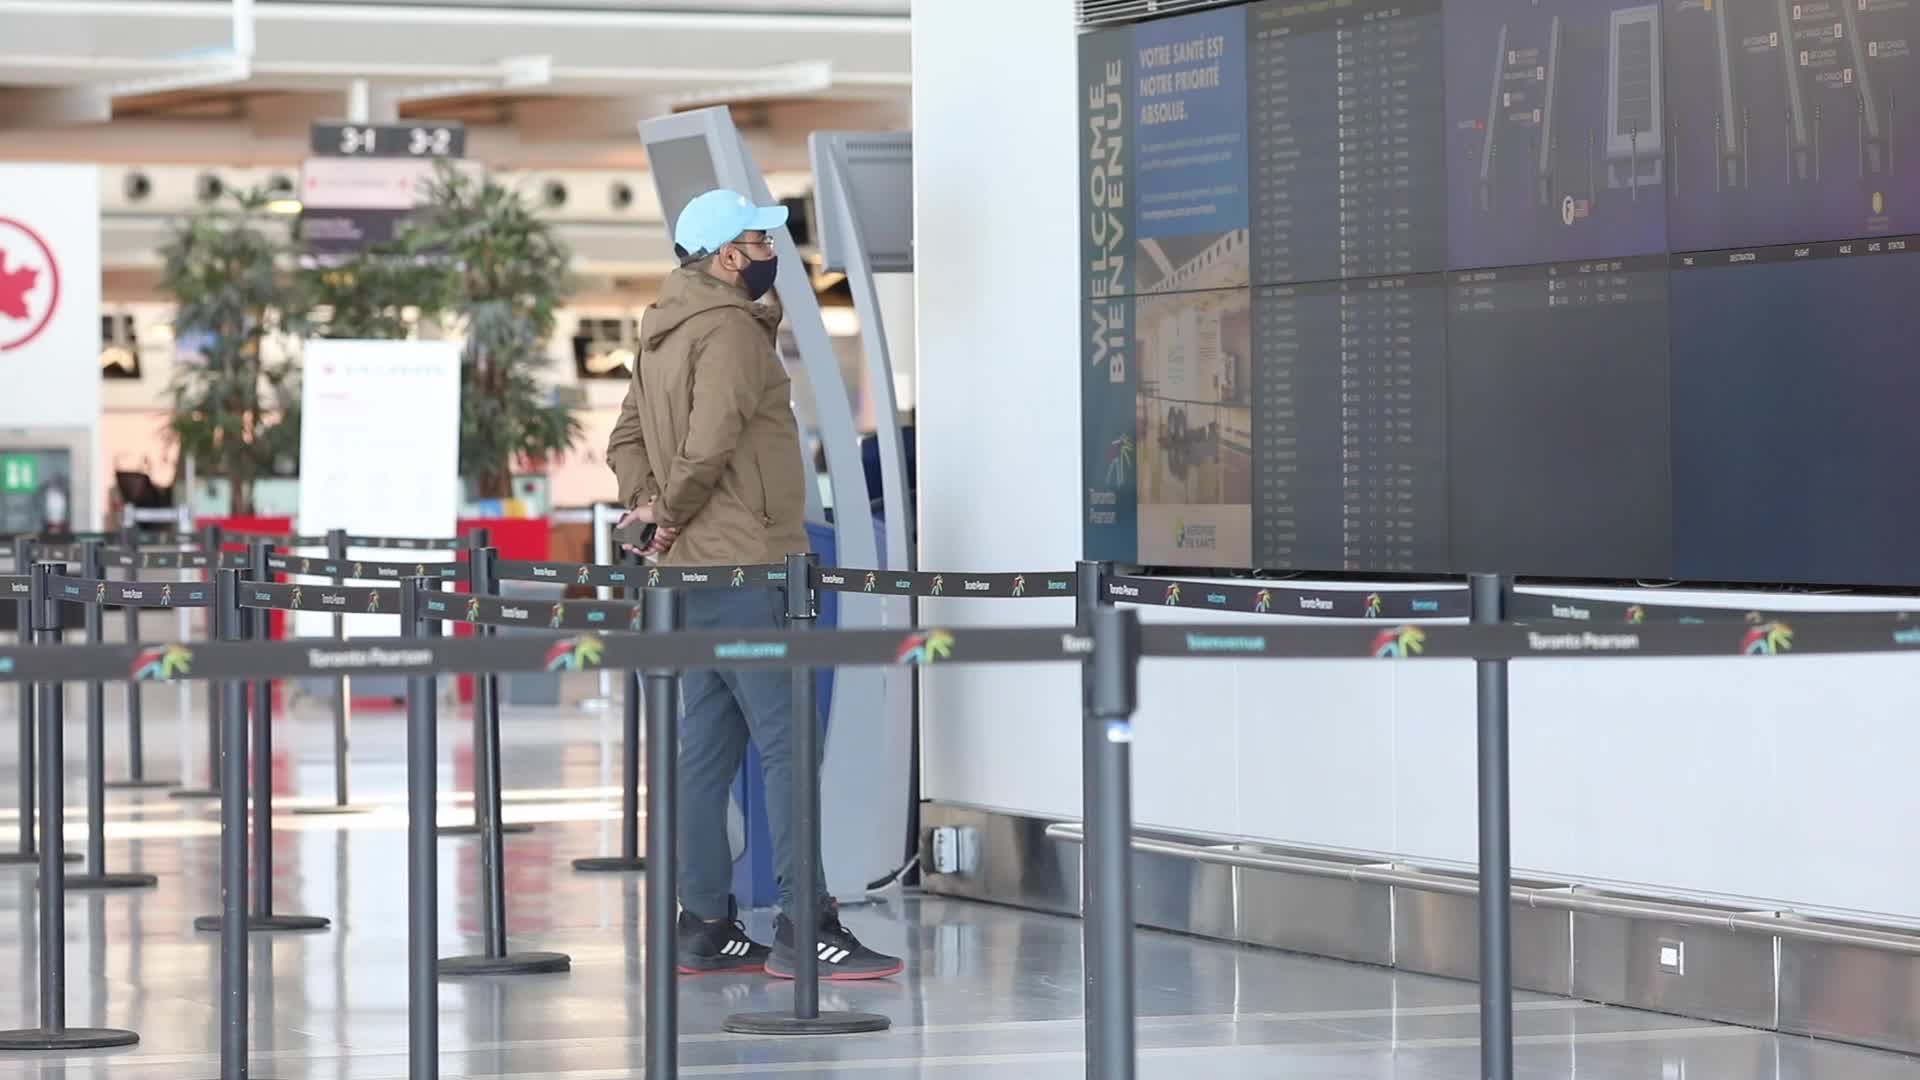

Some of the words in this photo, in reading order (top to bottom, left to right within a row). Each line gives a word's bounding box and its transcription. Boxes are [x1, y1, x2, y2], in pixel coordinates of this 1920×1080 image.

[1139, 45, 1170, 68] VOTRE
[1207, 36, 1224, 58] EST
[1140, 73, 1172, 96] NOTRE
[1140, 100, 1189, 125] ABSOLUE.
[341, 127, 376, 154] 3-1
[409, 127, 451, 155] 3-2
[1090, 82, 1107, 367] WELCOME
[1106, 58, 1125, 384] BIENVENUE
[1109, 583, 1122, 596] Toronto
[1123, 584, 1139, 597] Pearson
[1300, 596, 1314, 609] Toronto
[1315, 597, 1334, 610] Pearson
[1412, 600, 1439, 611] bienvenue
[716, 642, 787, 657] welcome
[1062, 634, 1093, 652] Toro
[1187, 634, 1265, 650] bienvenue
[1528, 632, 1581, 650] Toronto
[1582, 632, 1638, 649] Pearson
[308, 648, 367, 668] Toronto
[368, 647, 432, 666] Pearson
